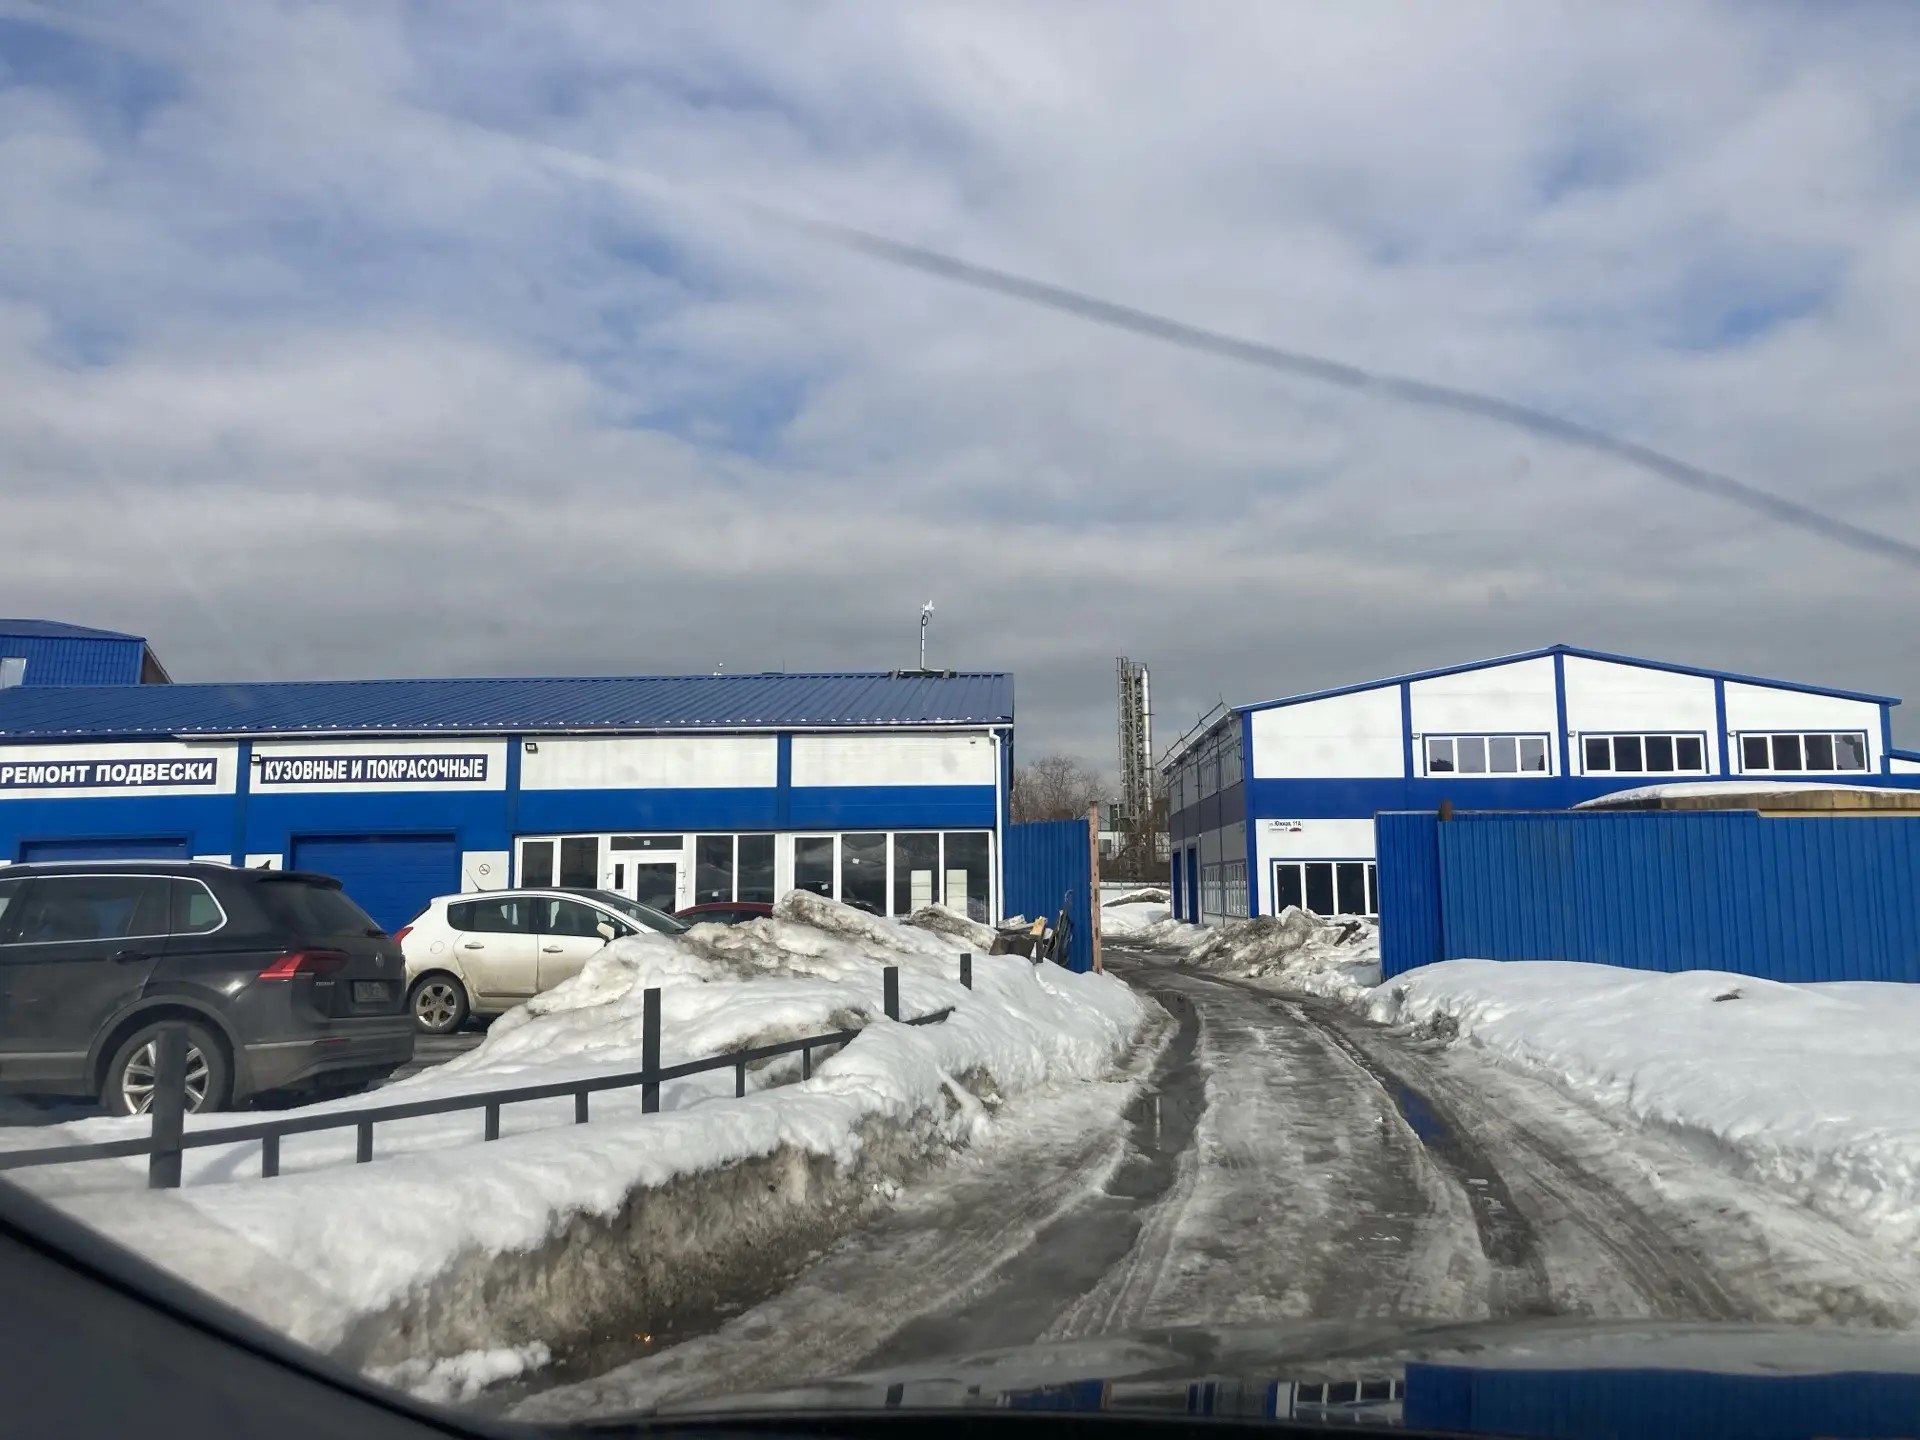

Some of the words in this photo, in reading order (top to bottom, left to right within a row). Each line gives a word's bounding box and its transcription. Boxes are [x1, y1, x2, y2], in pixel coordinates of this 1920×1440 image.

[1, 765, 91, 784] РЕМОНТ
[95, 763, 213, 785] ПОДВЕСКИ
[264, 760, 348, 781] КУЗОВНЫЕ
[351, 760, 363, 779] И
[366, 758, 484, 779] ПОКРАСОЧНЫЕ
